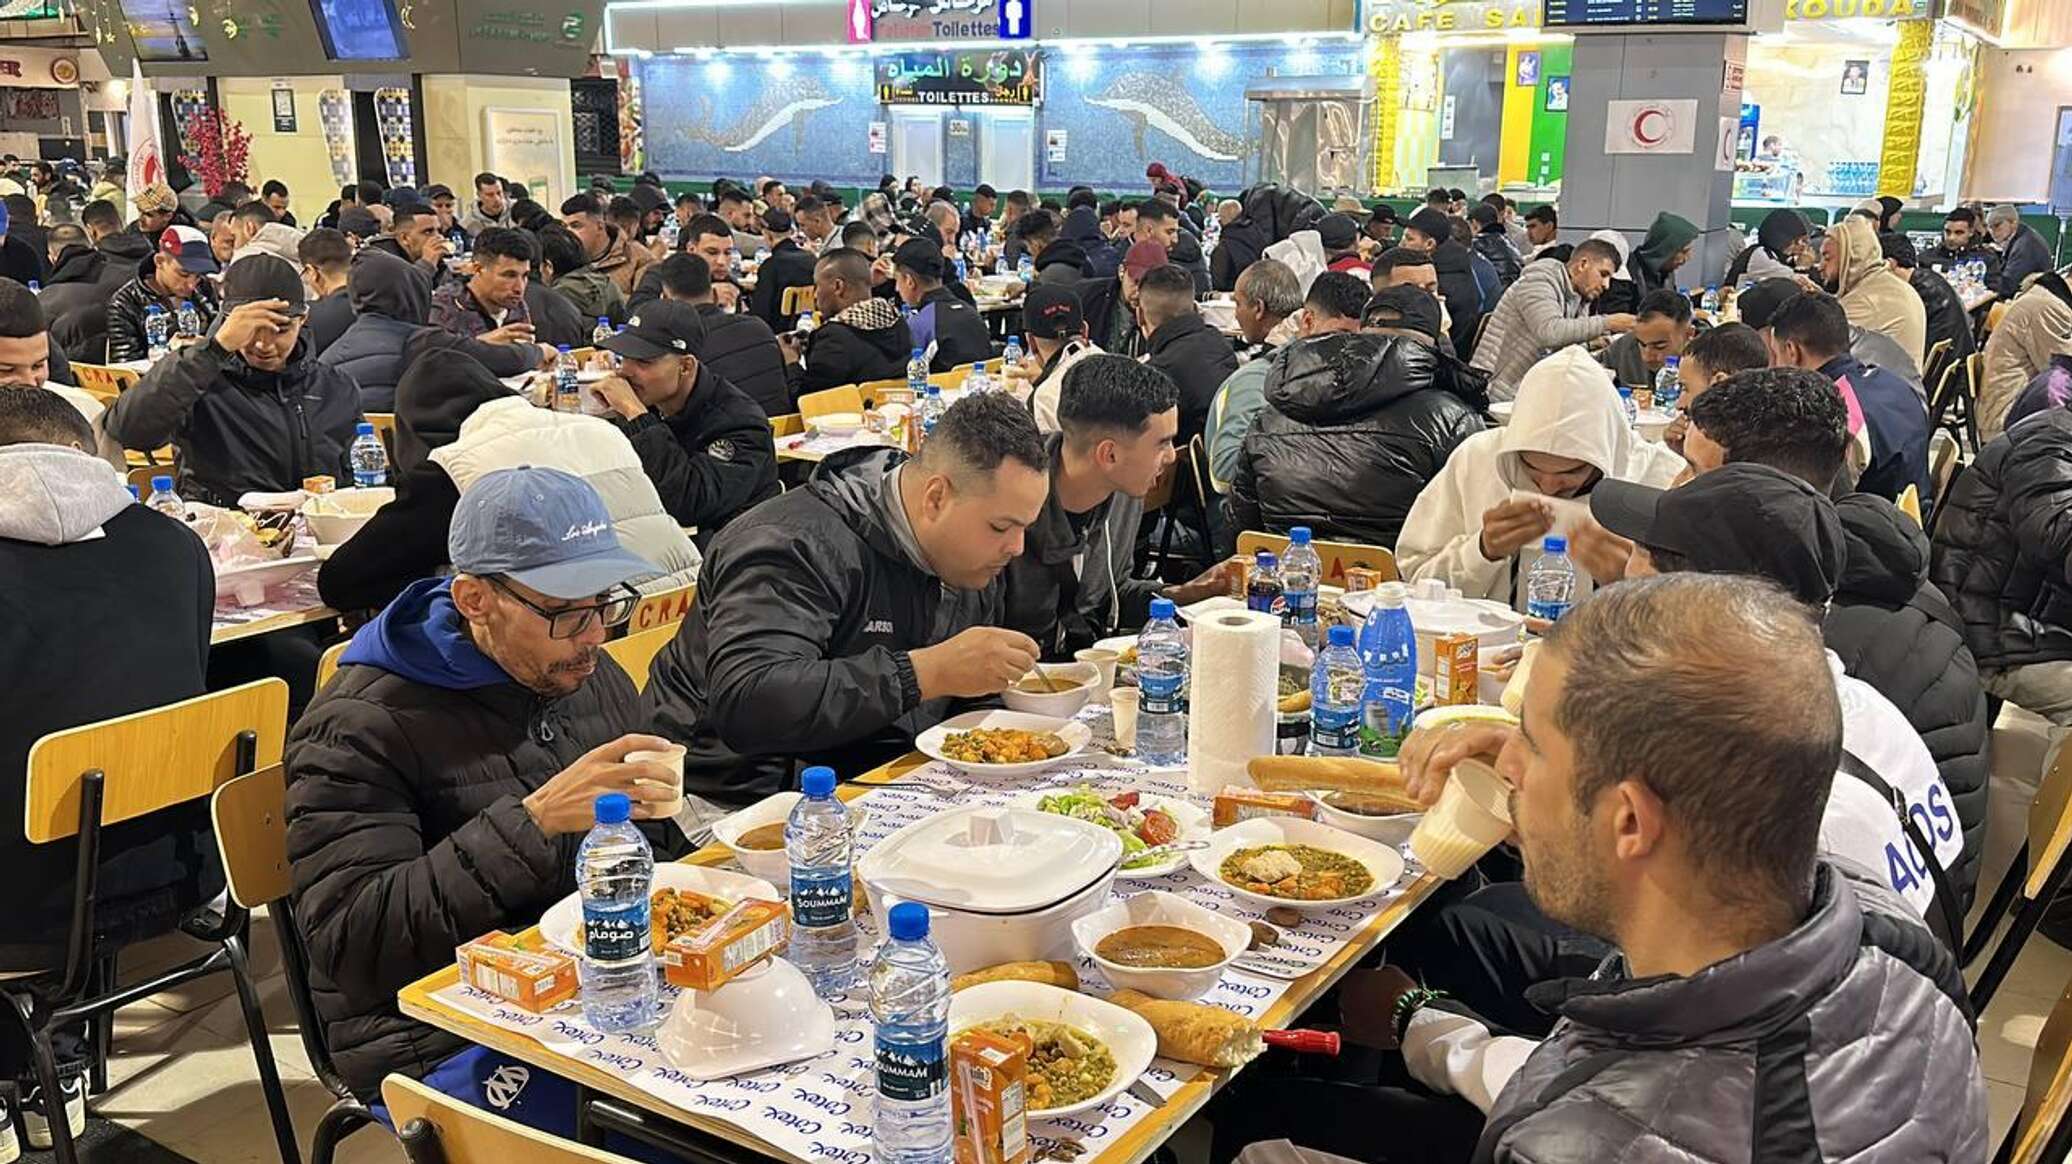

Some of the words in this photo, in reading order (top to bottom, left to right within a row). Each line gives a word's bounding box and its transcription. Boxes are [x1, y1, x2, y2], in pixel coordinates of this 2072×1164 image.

[933, 21, 999, 37] Toilettes
[917, 91, 990, 104] TOILETTES
[640, 590, 688, 628] CRA
[588, 928, 634, 943] صومام
[1218, 979, 1271, 999] Cotex
[792, 1088, 851, 1115] Cotex
[763, 1106, 822, 1135] Cotex
[1049, 1116, 1108, 1138] Cotex
